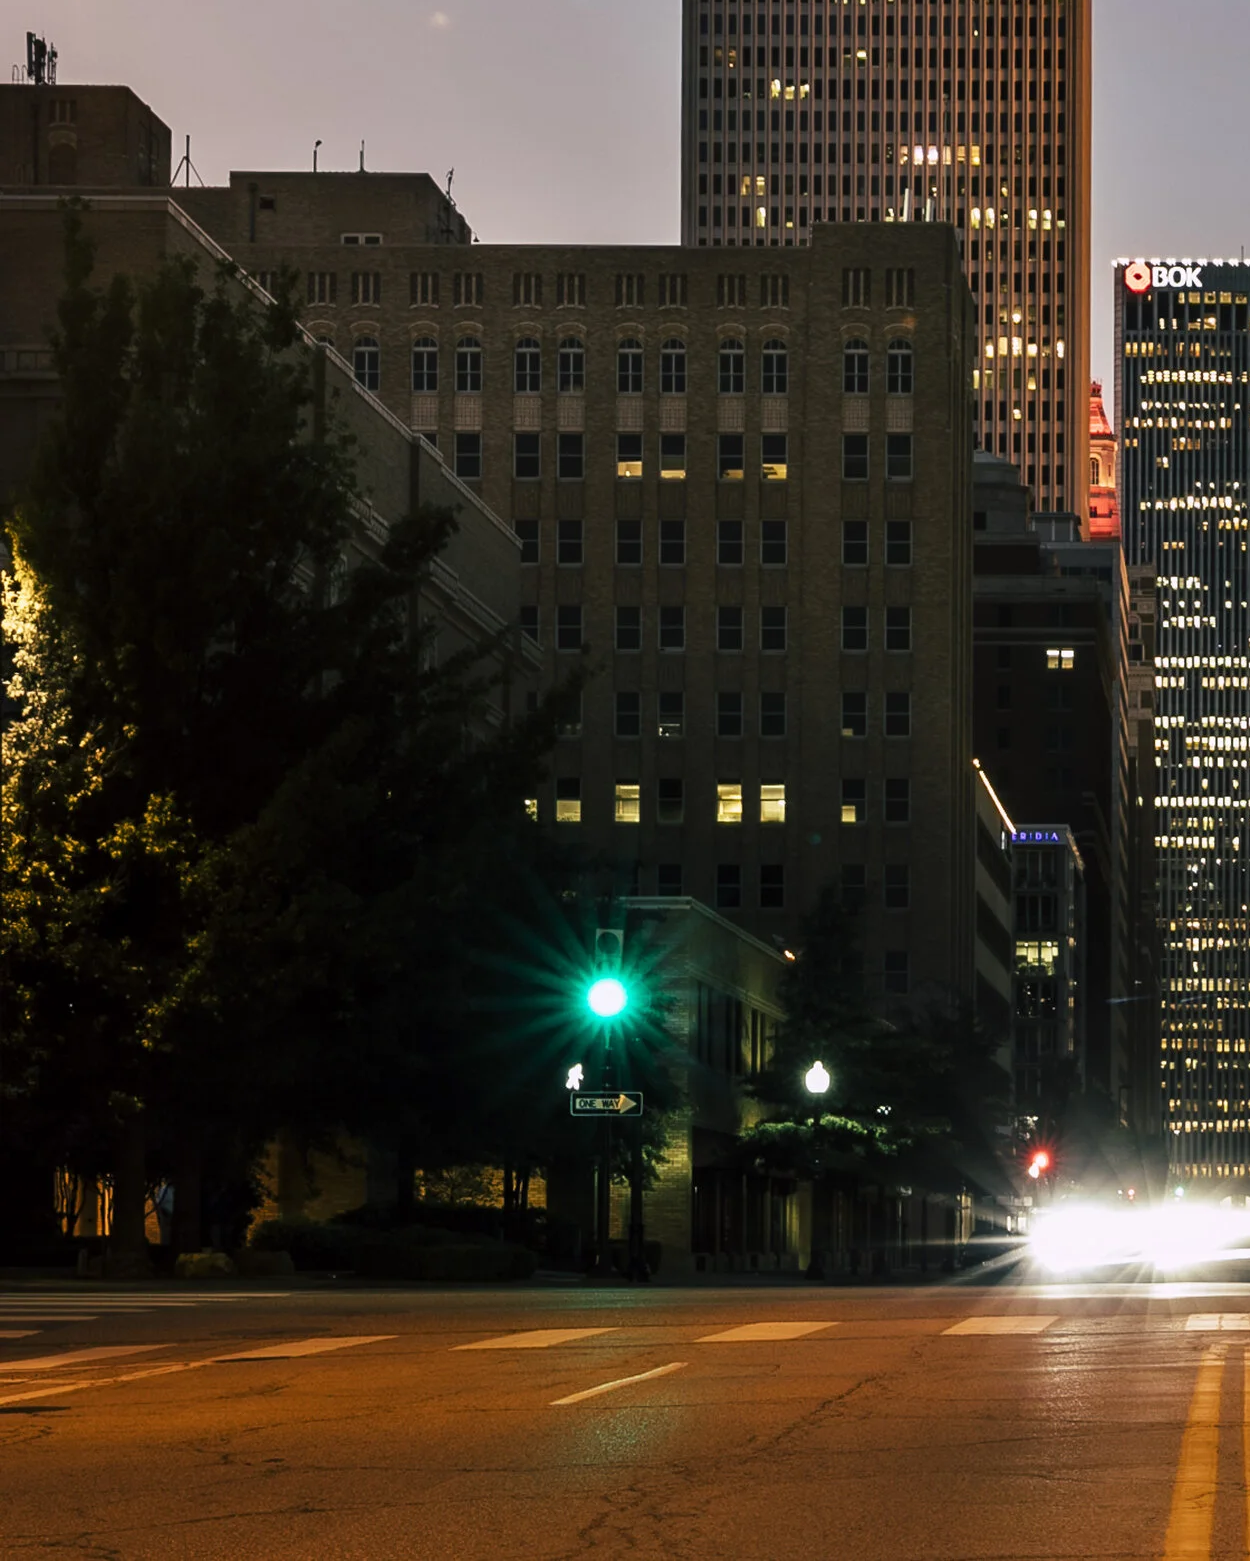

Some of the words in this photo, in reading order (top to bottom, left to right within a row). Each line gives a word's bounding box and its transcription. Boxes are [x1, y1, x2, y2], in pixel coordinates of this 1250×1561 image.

[1152, 266, 1203, 288] BOK
[578, 1098, 597, 1108] ONE
[601, 1098, 620, 1108] WAY
